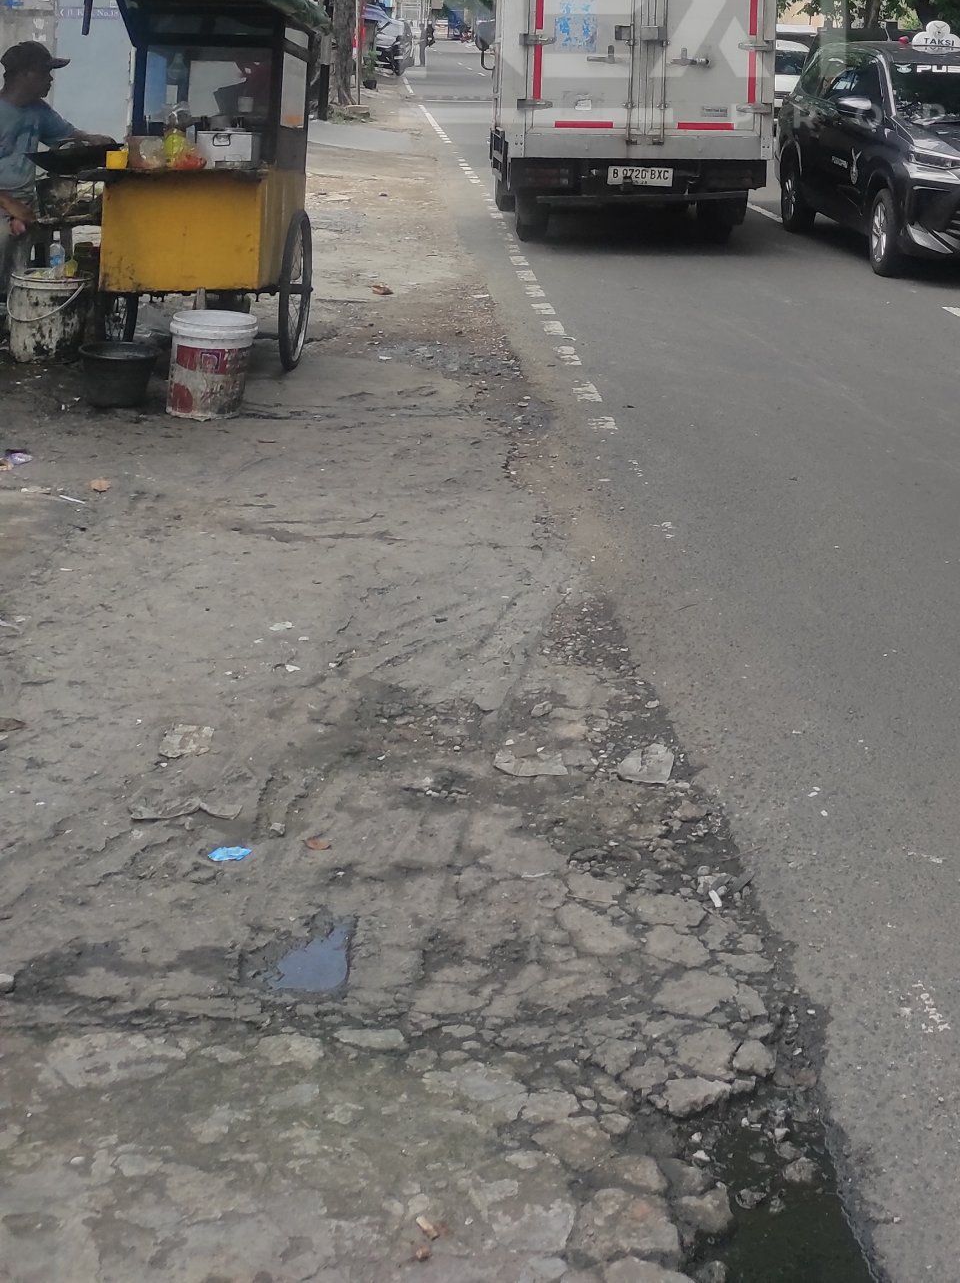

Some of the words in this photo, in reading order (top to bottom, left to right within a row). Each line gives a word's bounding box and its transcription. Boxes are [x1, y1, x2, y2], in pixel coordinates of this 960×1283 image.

[923, 37, 955, 47] TAKSI
[612, 168, 619, 179] B
[650, 169, 669, 180] BXC
